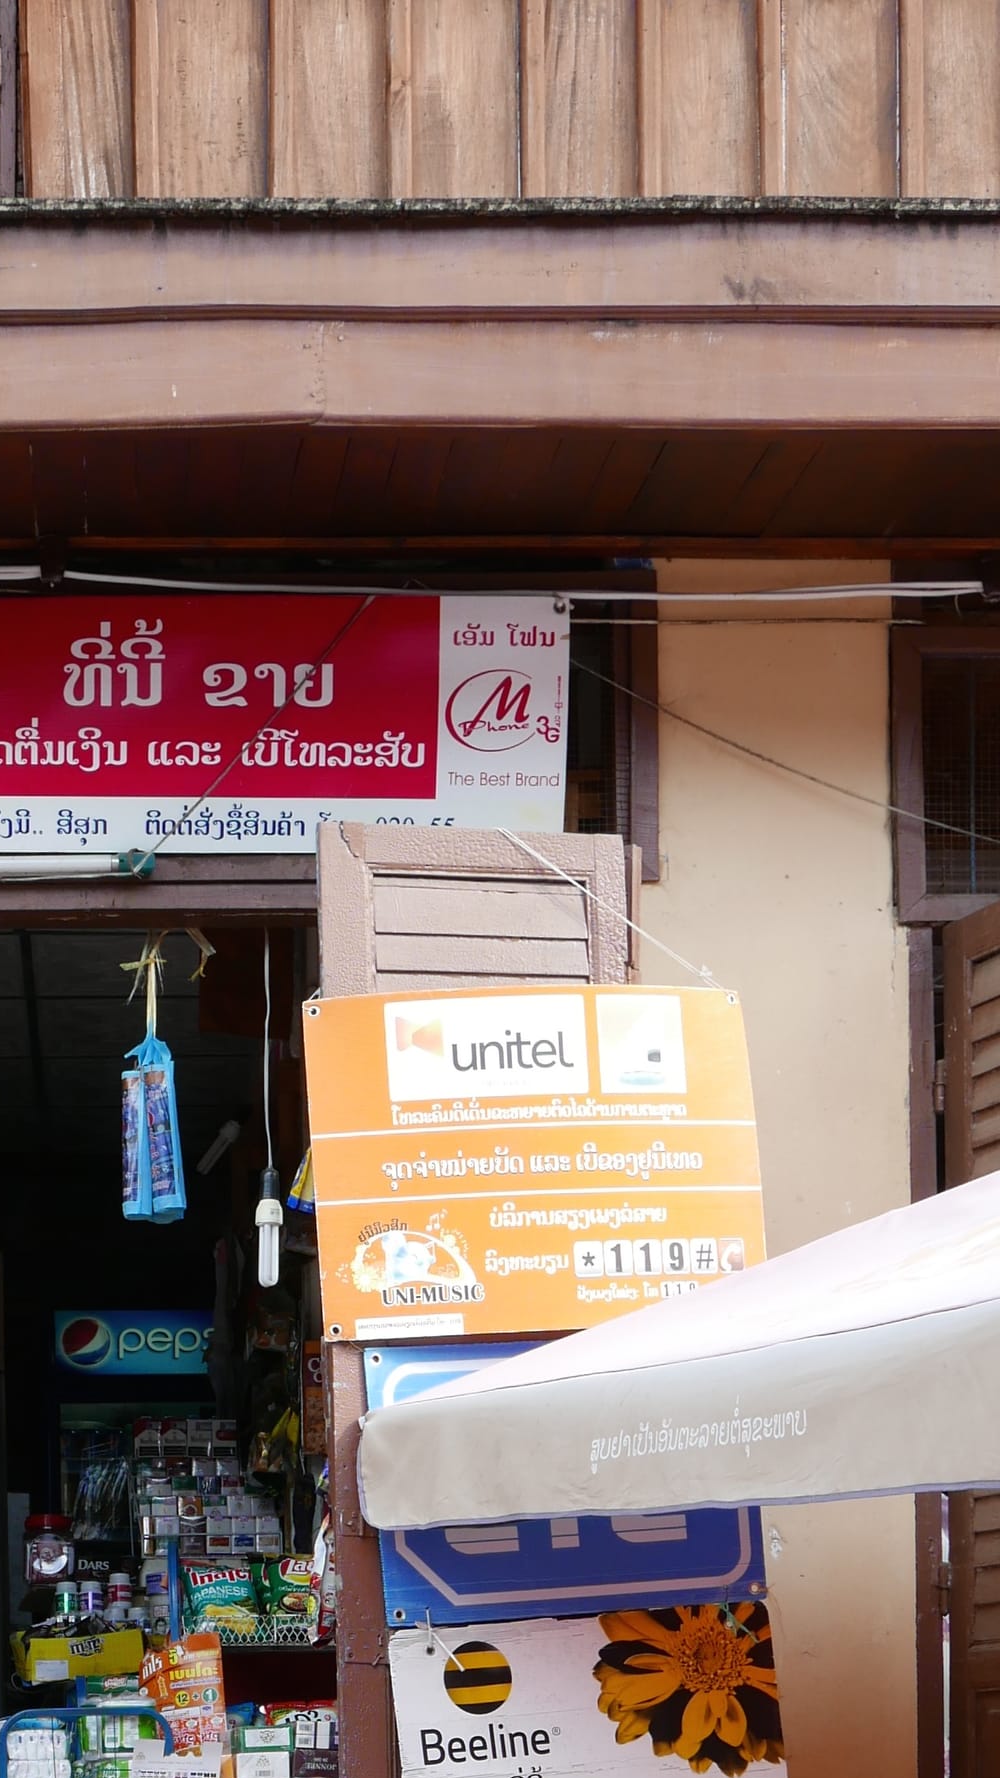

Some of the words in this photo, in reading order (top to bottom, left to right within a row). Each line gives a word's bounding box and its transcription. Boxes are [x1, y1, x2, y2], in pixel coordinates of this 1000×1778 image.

[453, 623, 495, 646] ເອັມ
[63, 619, 166, 707] ທີ່ນີ້
[203, 662, 334, 707] ຂາຍ
[147, 741, 222, 766] ແລະ
[241, 727, 426, 768] ເບີໂທລະສັບ
[448, 771, 474, 786] The
[480, 772, 510, 787] Best
[516, 773, 560, 787] Brand
[451, 1029, 574, 1071] unitel
[530, 1151, 572, 1176] ແລະ
[382, 1284, 484, 1306] UNI-MUSIC
[78, 1559, 110, 1570] DARS
